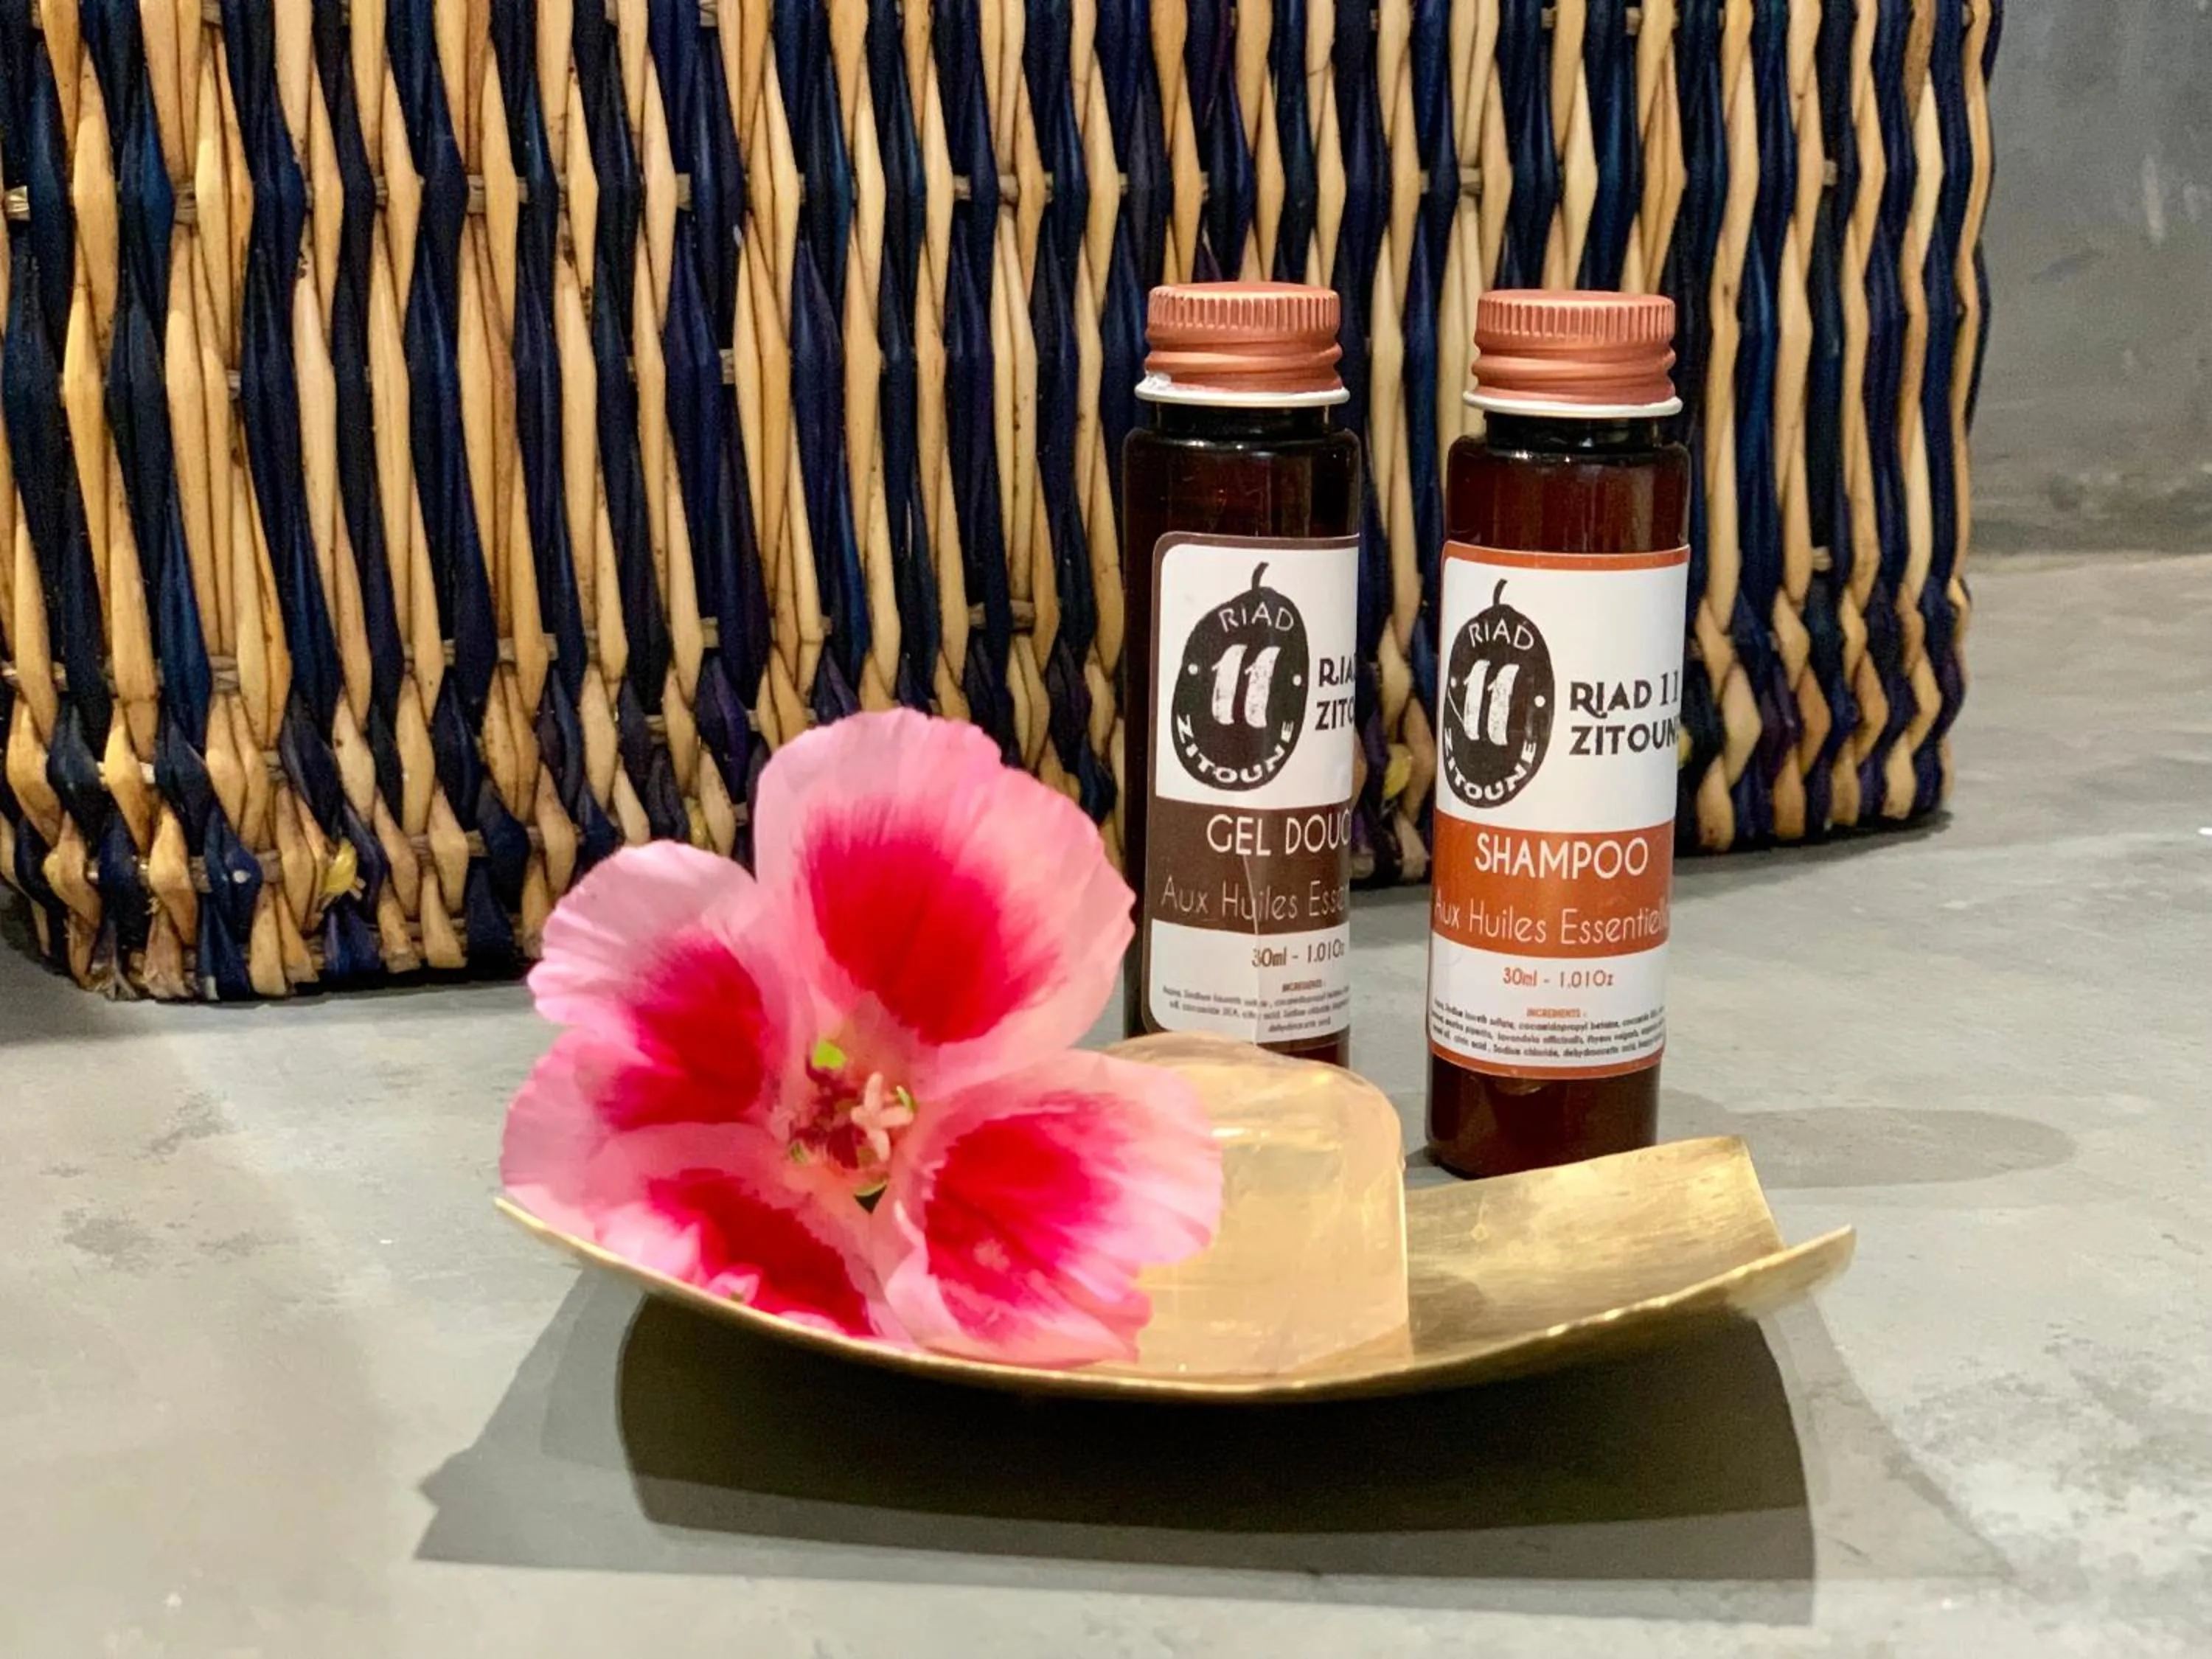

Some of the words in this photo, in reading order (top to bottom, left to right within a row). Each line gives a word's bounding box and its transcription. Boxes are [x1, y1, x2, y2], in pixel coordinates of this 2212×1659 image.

[1218, 602, 1294, 633] RIAD
[1468, 619, 1534, 650] RIAD
[1211, 644, 1281, 728] 11
[1464, 659, 1520, 746] 11
[1569, 678, 1652, 719] RIAD
[1659, 669, 1679, 706] 11
[1177, 714, 1294, 784] ZITOUNE
[1444, 727, 1537, 800] ZITOUNE
[1206, 813, 1271, 856] GEL
[1475, 832, 1649, 880] SHAMPOO
[1161, 874, 1208, 914] Aux
[1222, 880, 1298, 922] Huiles
[1434, 886, 1460, 930] Aux
[1469, 897, 1547, 945] Huiles
[1251, 945, 1287, 968] 30ml
[1502, 967, 1538, 987] 30ml
[1559, 969, 1615, 990] 1.01Oz
